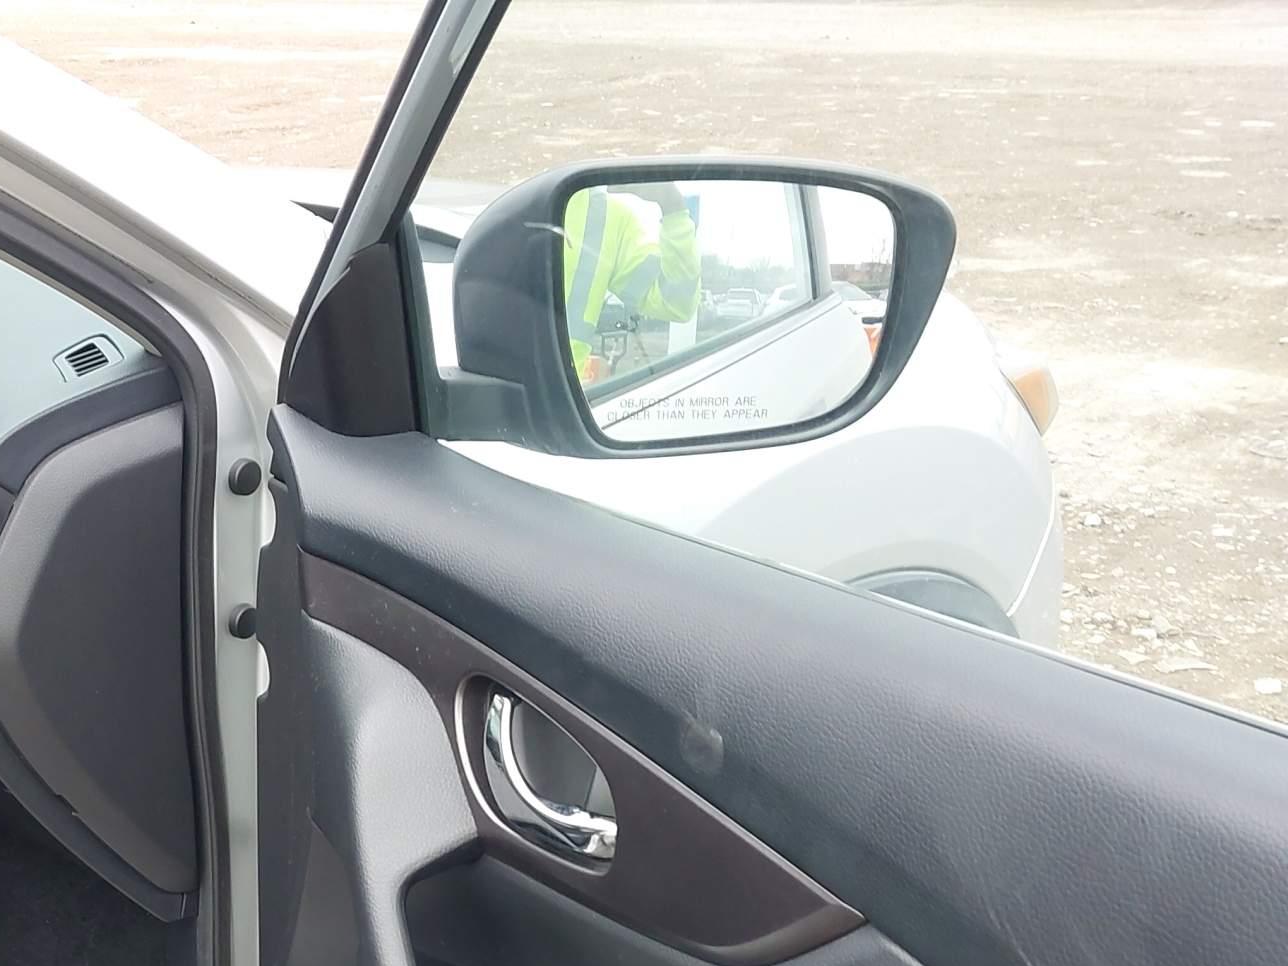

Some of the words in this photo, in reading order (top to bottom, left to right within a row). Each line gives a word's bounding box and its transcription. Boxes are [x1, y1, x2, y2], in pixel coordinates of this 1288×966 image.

[619, 398, 670, 408] OBJECTS
[675, 398, 685, 407] IN
[689, 396, 729, 407] MIRROR
[735, 396, 757, 406] ARE
[607, 410, 650, 421] CLOSER
[657, 409, 685, 419] THAN
[692, 409, 717, 419] THEY
[723, 408, 768, 419] APPEAR
